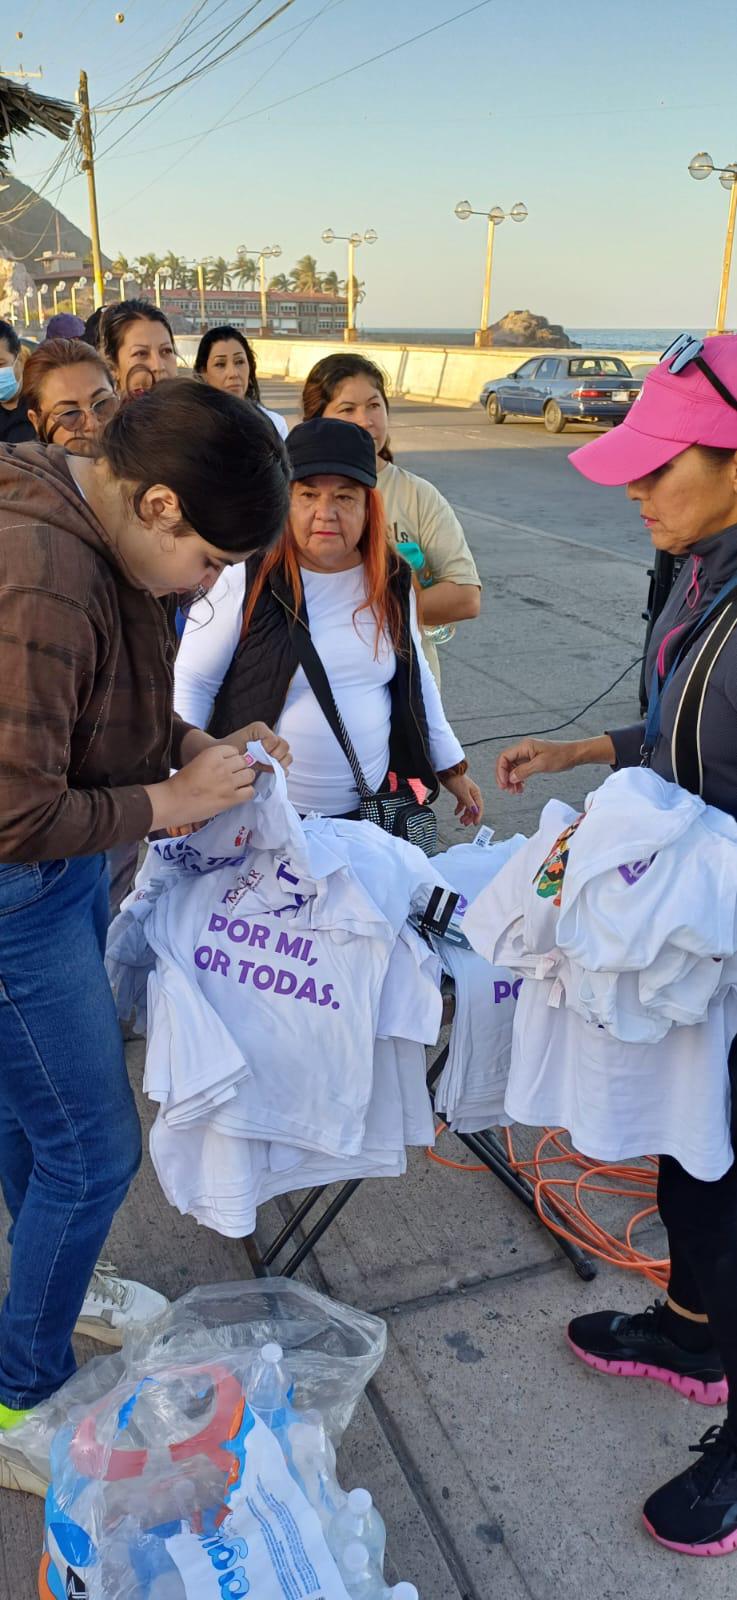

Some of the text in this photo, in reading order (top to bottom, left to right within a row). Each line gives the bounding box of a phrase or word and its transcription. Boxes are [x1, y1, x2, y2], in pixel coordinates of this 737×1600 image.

[208, 912, 318, 966] POR MI,
[238, 959, 340, 1010] TODAS.
